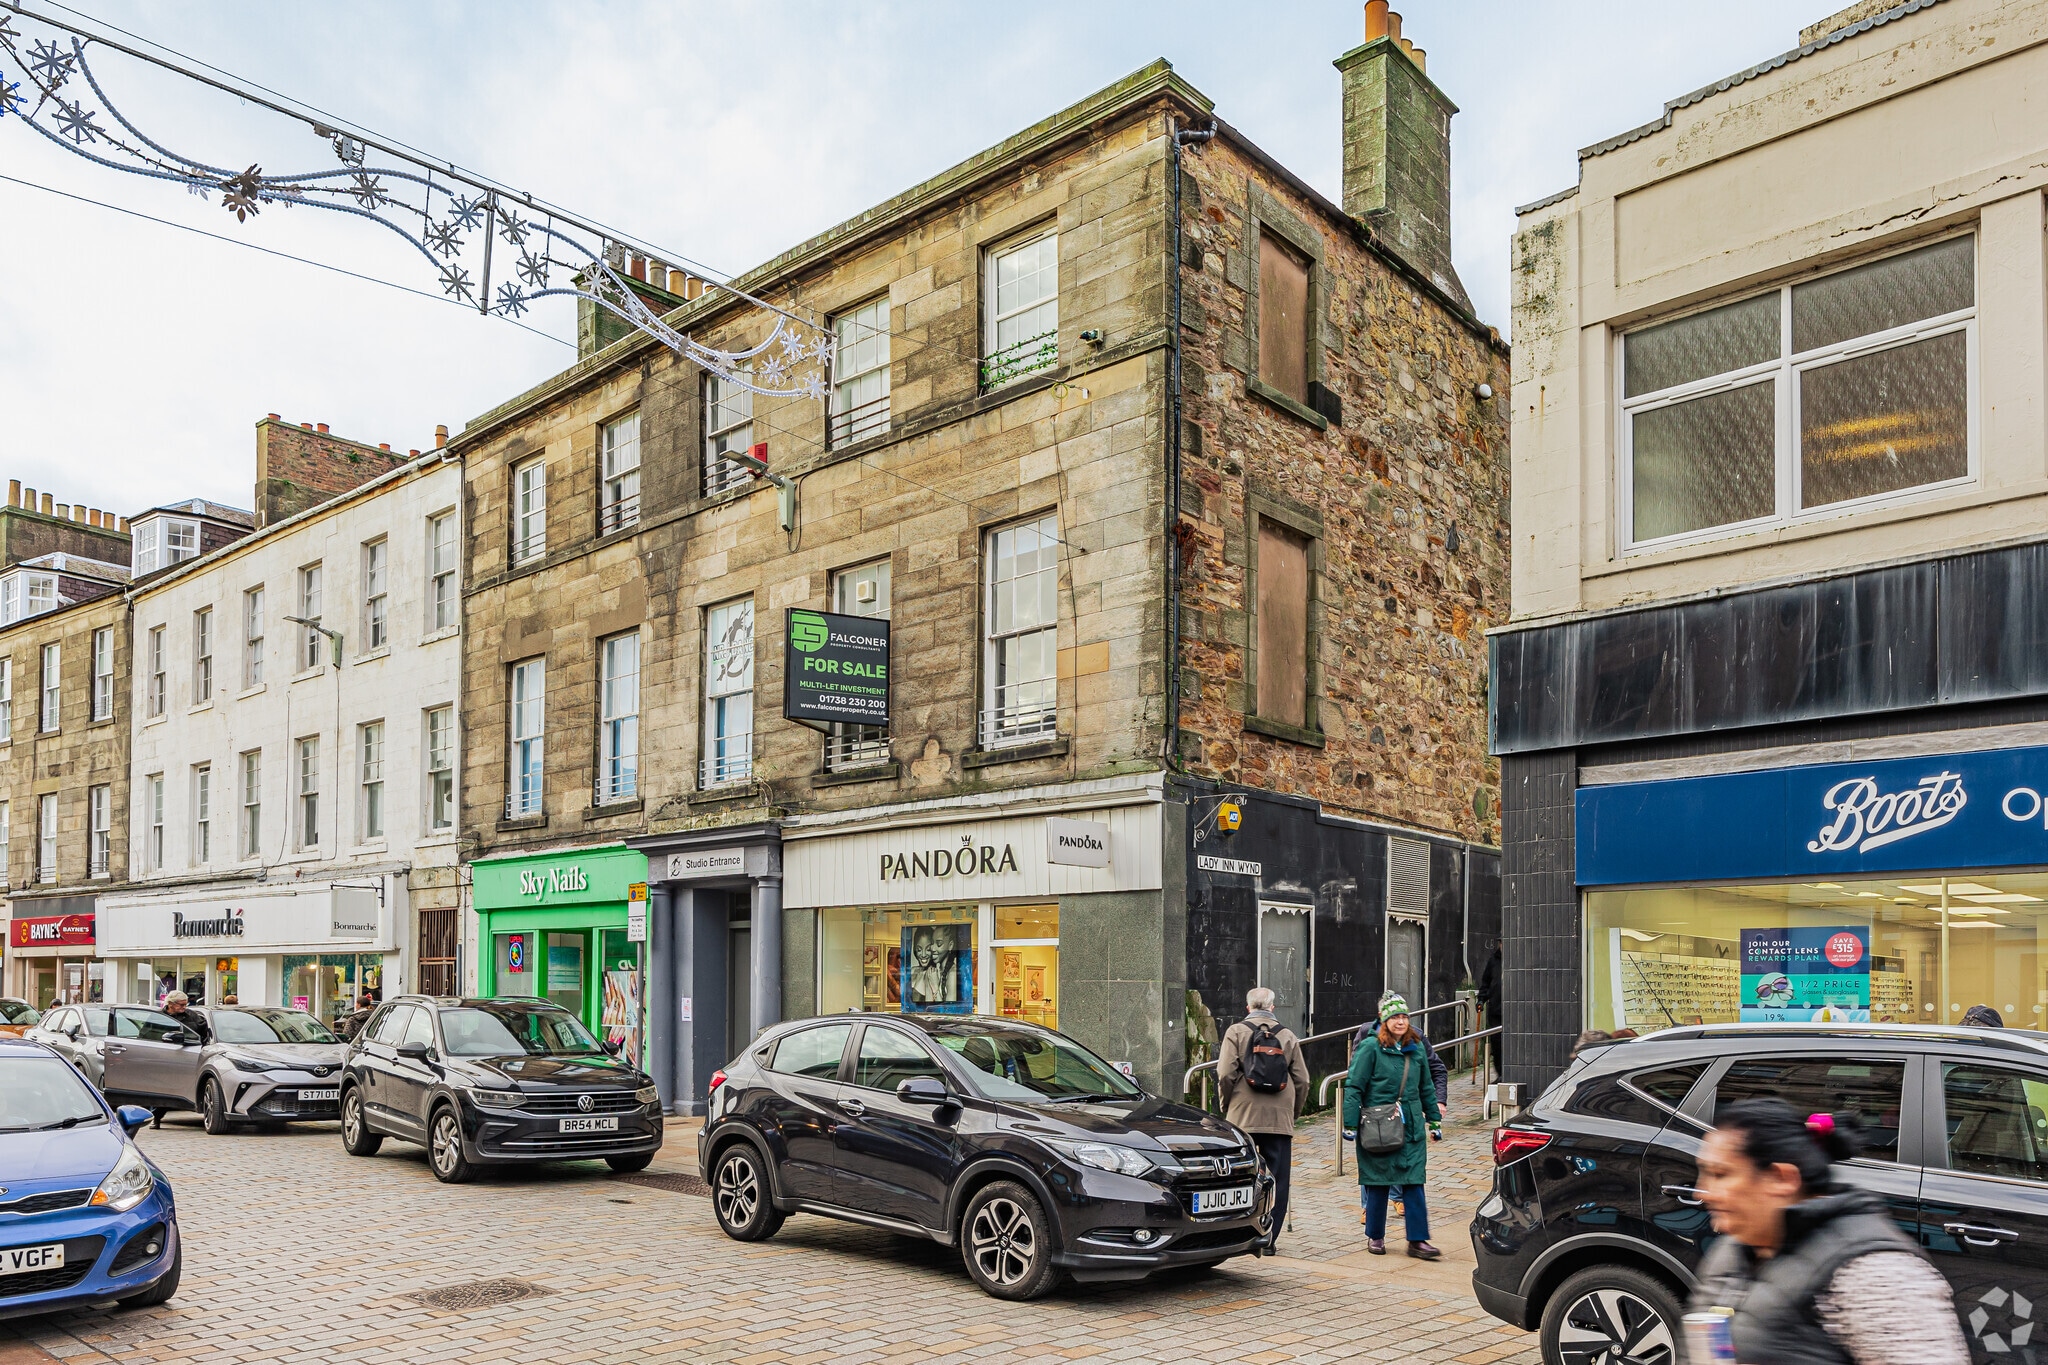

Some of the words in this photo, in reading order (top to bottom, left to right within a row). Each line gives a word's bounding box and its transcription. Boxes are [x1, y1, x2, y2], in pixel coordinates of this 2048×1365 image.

[831, 633, 887, 648] FALCONER
[804, 656, 839, 674] FOR
[842, 661, 886, 679] SALE
[799, 680, 839, 691] MULTI-LET
[840, 684, 886, 695] INVESTMENT
[800, 702, 886, 716] www.falconerproperty.co.uk
[819, 694, 847, 705] 01738
[848, 697, 866, 707] 230
[868, 699, 886, 709] 200
[1807, 770, 1968, 854] Boots
[2002, 787, 2048, 831] O
[1059, 835, 1103, 851] PANDORA
[685, 858, 708, 869] Studio
[709, 856, 741, 867] Entrance
[880, 843, 1018, 881] PANDORA
[1199, 856, 1218, 869] LADY
[1222, 859, 1235, 872] INN
[1238, 861, 1260, 875] WYND
[520, 869, 546, 901] Sky
[549, 865, 588, 893] Nails
[172, 908, 244, 938] Bonmarché
[333, 921, 377, 931] Bonmarché
[31, 923, 60, 940] BAYNE'S
[1748, 940, 1768, 948] JOIN
[1748, 947, 1792, 955] CONTACT
[1748, 954, 1792, 962] REWARDS
[1801, 980, 1818, 988] 1/2
[1824, 980, 1860, 988] PRICE
[303, 1091, 324, 1099] ST71
[564, 1119, 592, 1131] BR54
[594, 1119, 615, 1130] MCL
[1203, 1192, 1227, 1209] JJ10
[1229, 1189, 1249, 1206] JRJ
[11, 1247, 55, 1269] VGF
